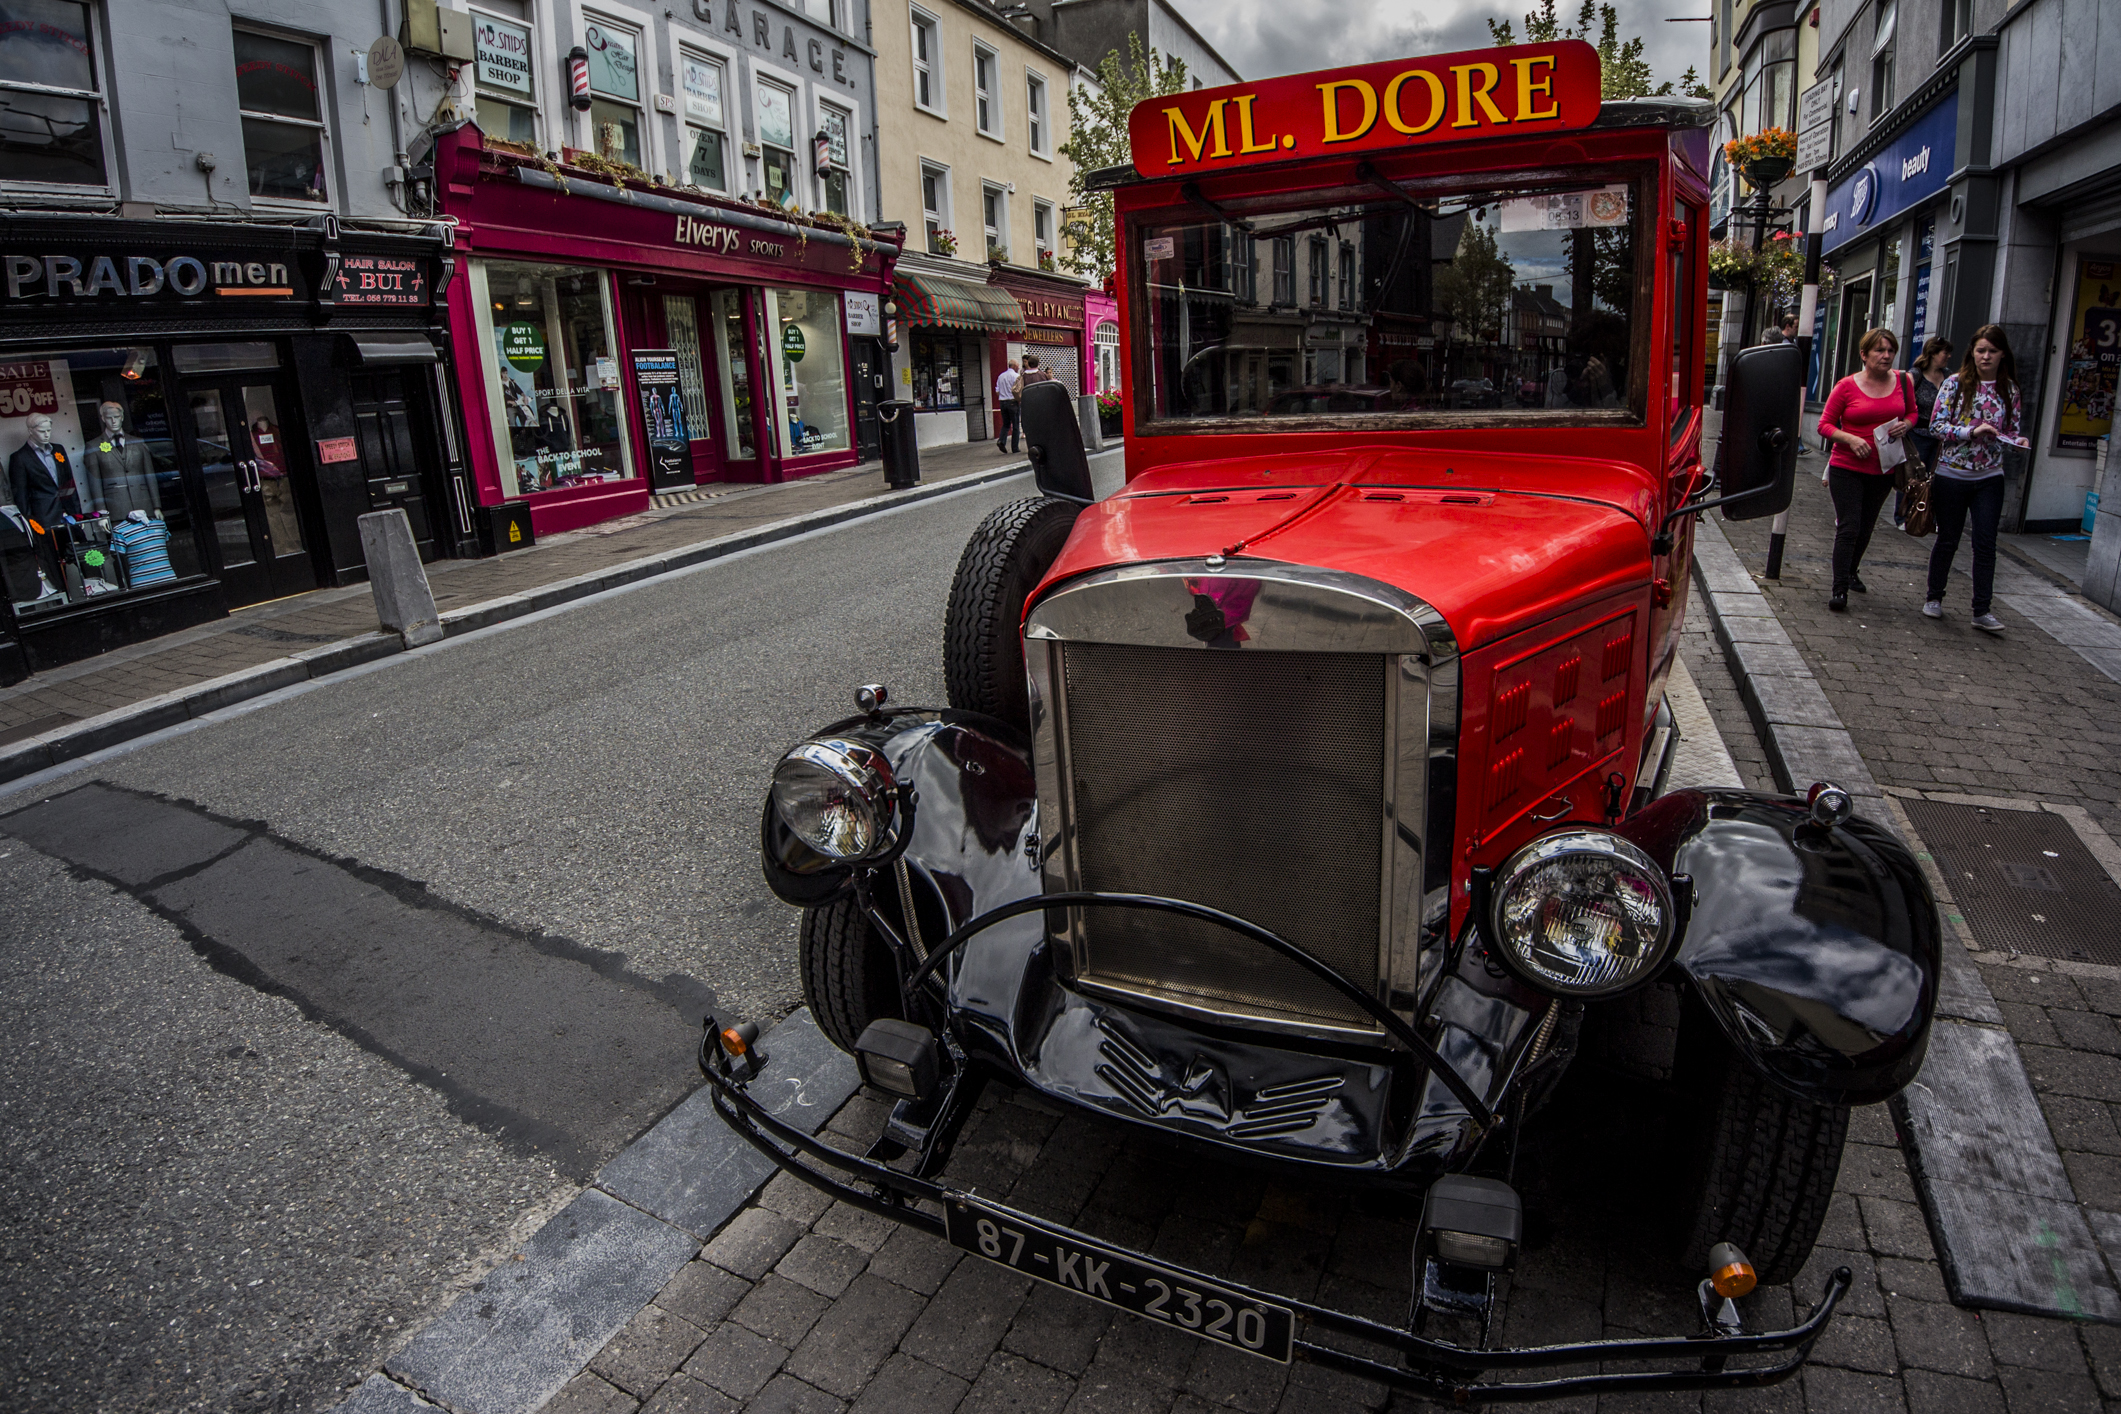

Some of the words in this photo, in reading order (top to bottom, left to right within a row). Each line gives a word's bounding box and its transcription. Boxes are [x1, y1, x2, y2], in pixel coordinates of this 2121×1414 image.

[479, 50, 528, 72] BARBER
[275, 62, 316, 92] STITCH
[488, 67, 521, 84] SHOP
[686, 86, 719, 104] BARBER
[1820, 83, 1829, 94] BAY
[660, 97, 674, 108] SPS
[692, 101, 714, 115] SHOP
[1811, 97, 1821, 108] ONLY
[1162, 94, 1296, 165] ML.
[1315, 54, 1560, 144] DORE
[690, 130, 714, 144] OPEN
[1812, 126, 1829, 139] Operation
[698, 146, 707, 161] 7
[1901, 144, 1931, 182] beauty
[693, 164, 716, 178] DAYS
[674, 214, 740, 255] Elverys
[749, 239, 785, 258] SPORTS
[344, 258, 375, 269] HAIR
[377, 259, 416, 271] SALON
[2089, 263, 2112, 273] Argos
[1, 255, 208, 299] PRADO
[209, 260, 290, 285] men
[359, 272, 403, 291] BUI
[342, 294, 365, 302] TEL:
[398, 295, 407, 303] 11
[512, 327, 526, 335] BUY
[527, 326, 532, 335] 1
[1023, 330, 1064, 343] JEWELLERS
[513, 336, 526, 345] GET
[527, 336, 533, 344] 1
[506, 346, 524, 355] HALF
[524, 346, 544, 355] PRICE
[2100, 352, 2115, 362] on
[635, 362, 676, 370] FOOTBALANCE
[34, 391, 54, 406] OFF
[535, 388, 554, 397] SPORT
[2062, 439, 2087, 447] Entertain
[536, 446, 550, 456] THE
[537, 453, 559, 463] BACK
[559, 452, 570, 460] TO
[571, 447, 603, 458] SCHOOL
[558, 461, 581, 472] EVENT
[976, 1219, 1266, 1349] 87-KK-2320
